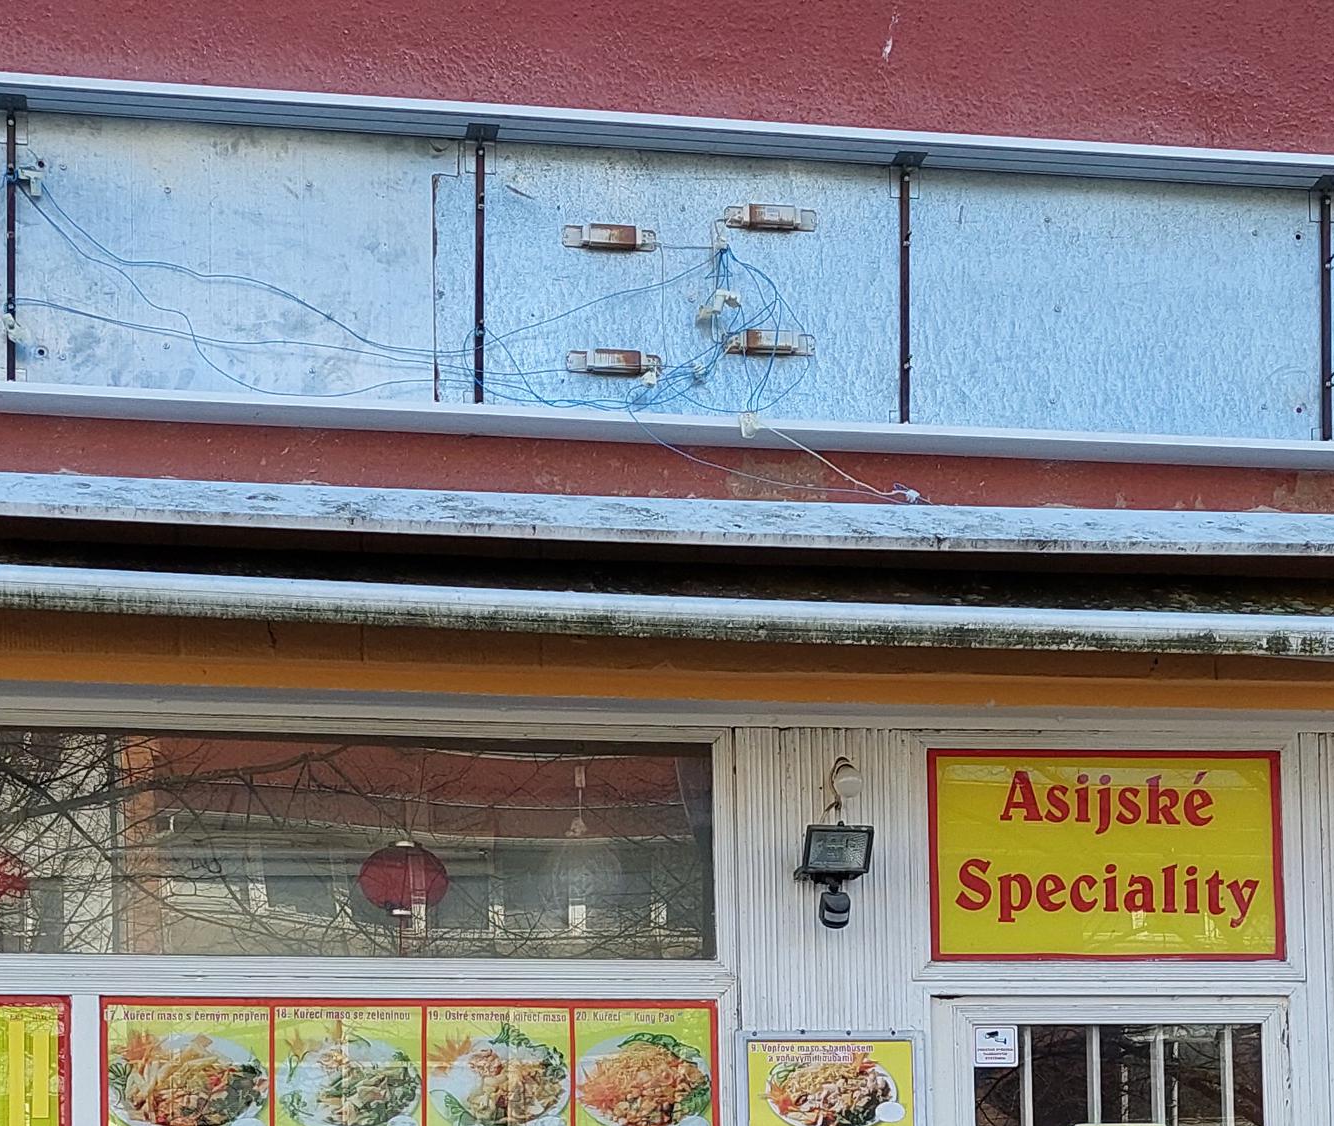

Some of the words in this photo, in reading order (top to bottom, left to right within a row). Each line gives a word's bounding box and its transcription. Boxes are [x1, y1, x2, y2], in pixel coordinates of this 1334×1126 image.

[1000, 770, 1214, 835] Asijské
[955, 858, 1259, 928] Speciality
[123, 1010, 155, 1021] Kuřecí
[157, 1010, 185, 1021] maso
[194, 1009, 229, 1022] černým
[233, 1010, 268, 1023] pepřem
[276, 1009, 289, 1019] 18.
[293, 1008, 323, 1020] Kuřecí
[325, 1010, 351, 1020] maso
[353, 1010, 365, 1020] se
[366, 1008, 410, 1021] zeleninou
[428, 1010, 441, 1021] 19.
[445, 1009, 468, 1021] Ostré
[471, 1009, 510, 1022] smažené
[575, 1010, 590, 1021] 20.
[592, 1009, 621, 1022] Kuřecí
[658, 1011, 675, 1022] Pao
[762, 1043, 794, 1052] Vepřové
